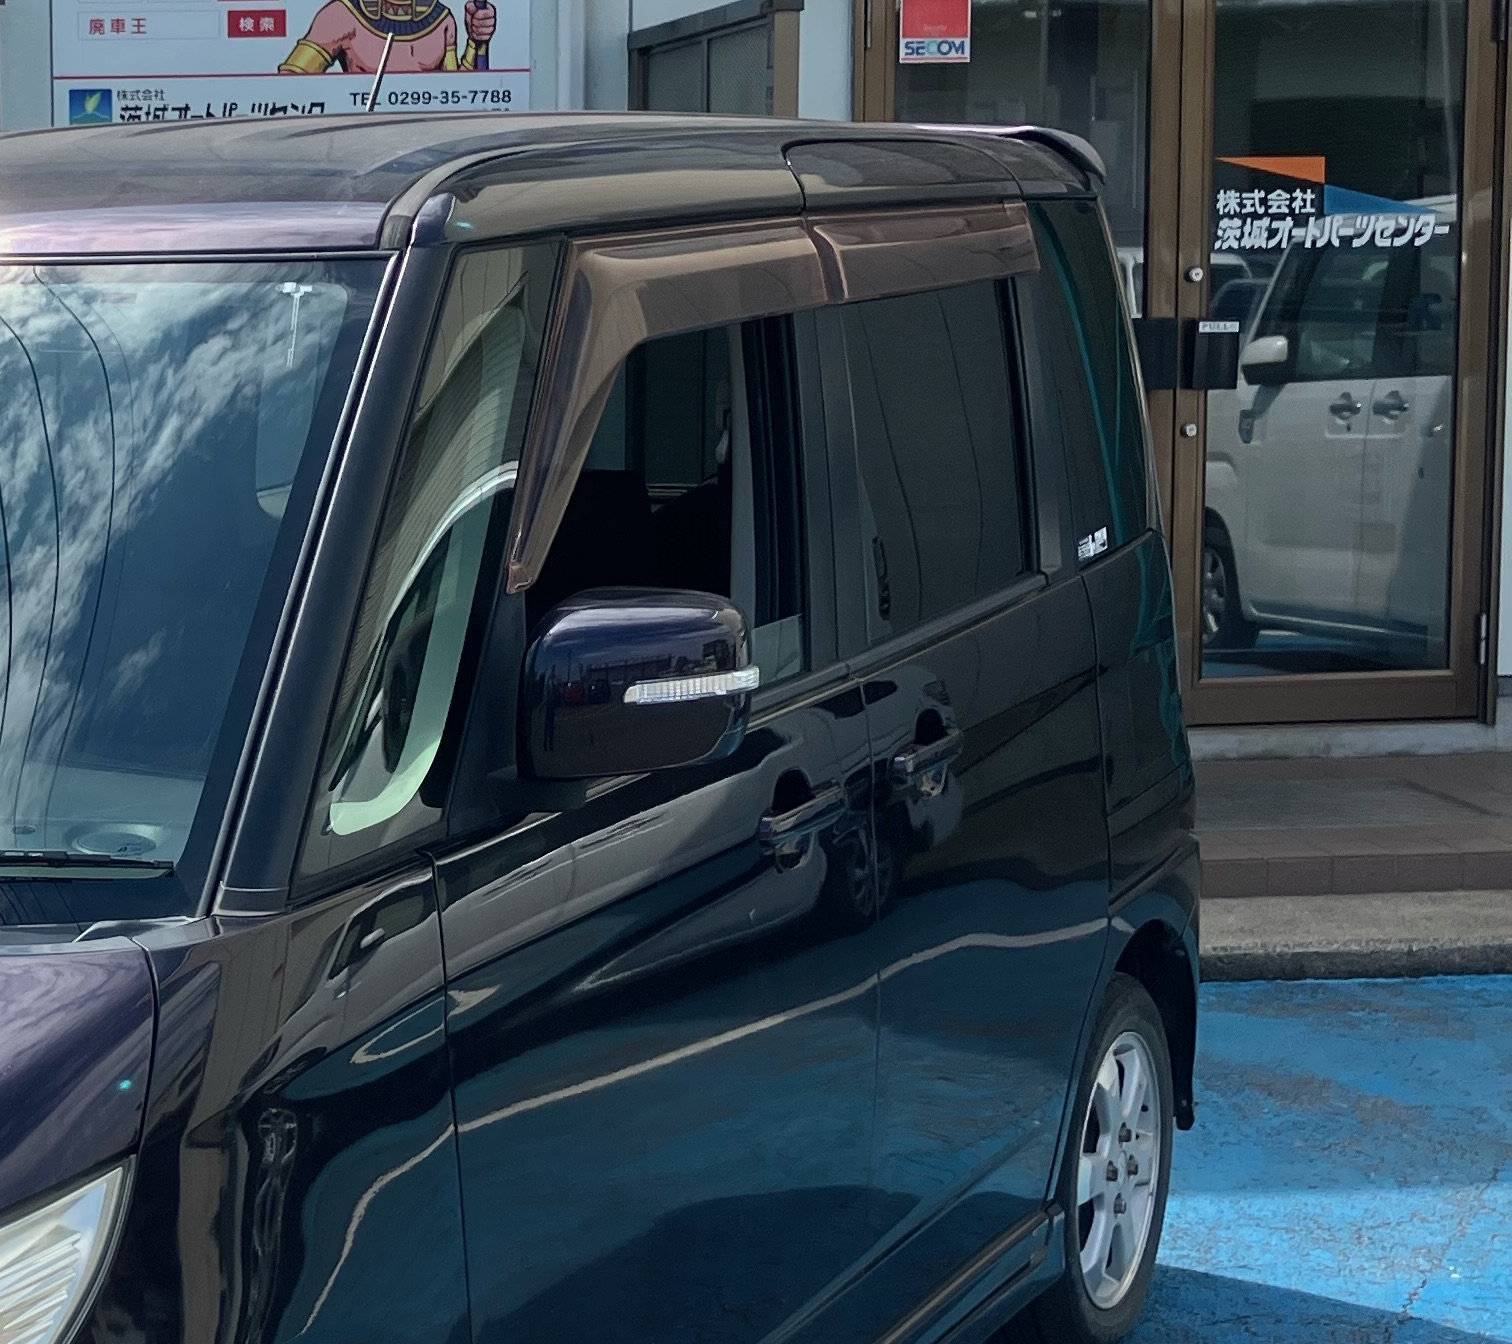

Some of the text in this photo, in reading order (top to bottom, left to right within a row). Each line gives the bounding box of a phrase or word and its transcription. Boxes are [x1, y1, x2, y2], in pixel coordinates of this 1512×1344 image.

[88, 17, 148, 36] 廃車王
[238, 16, 276, 33] 検索
[904, 39, 965, 56] SECOM
[388, 89, 513, 106] 0299-35-7788
[1215, 188, 1316, 215] 株式会社
[1214, 213, 1451, 250] 茨城オートパーツセンター
